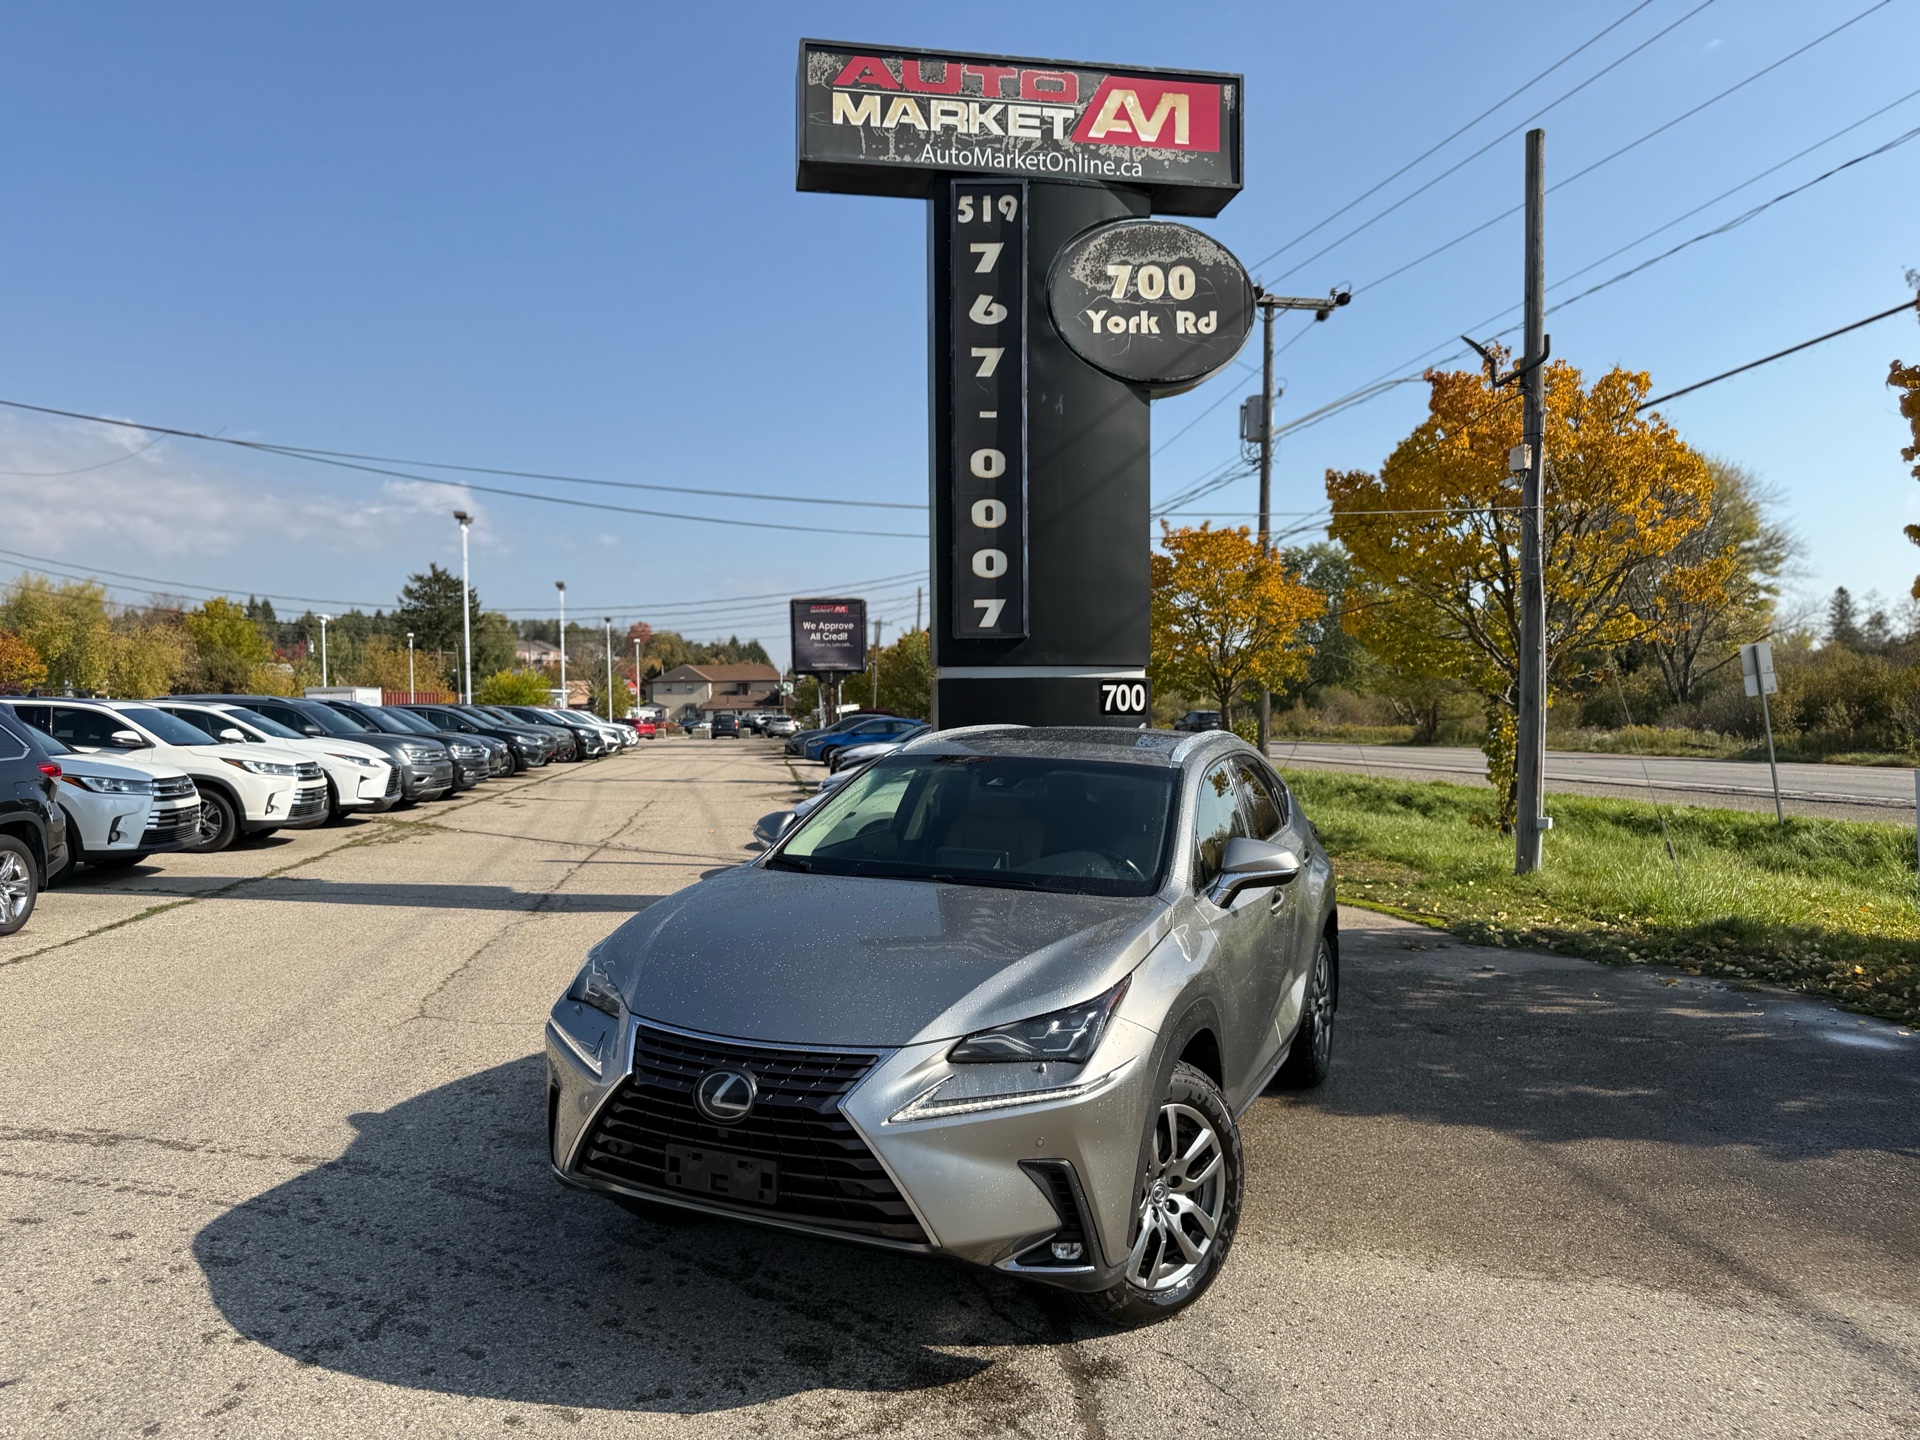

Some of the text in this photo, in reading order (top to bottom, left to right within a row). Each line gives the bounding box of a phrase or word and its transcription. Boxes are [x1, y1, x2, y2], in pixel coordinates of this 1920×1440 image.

[833, 56, 1079, 104] AUTO
[832, 92, 1076, 140] MARKET
[921, 143, 1144, 178] AutoMarketOnline.ca
[957, 195, 1018, 224] 519
[1107, 264, 1196, 300] 700
[1086, 310, 1218, 334] York Rd
[803, 622, 854, 631] We Approve
[810, 633, 848, 641] All Credit
[1101, 684, 1146, 712] 700
